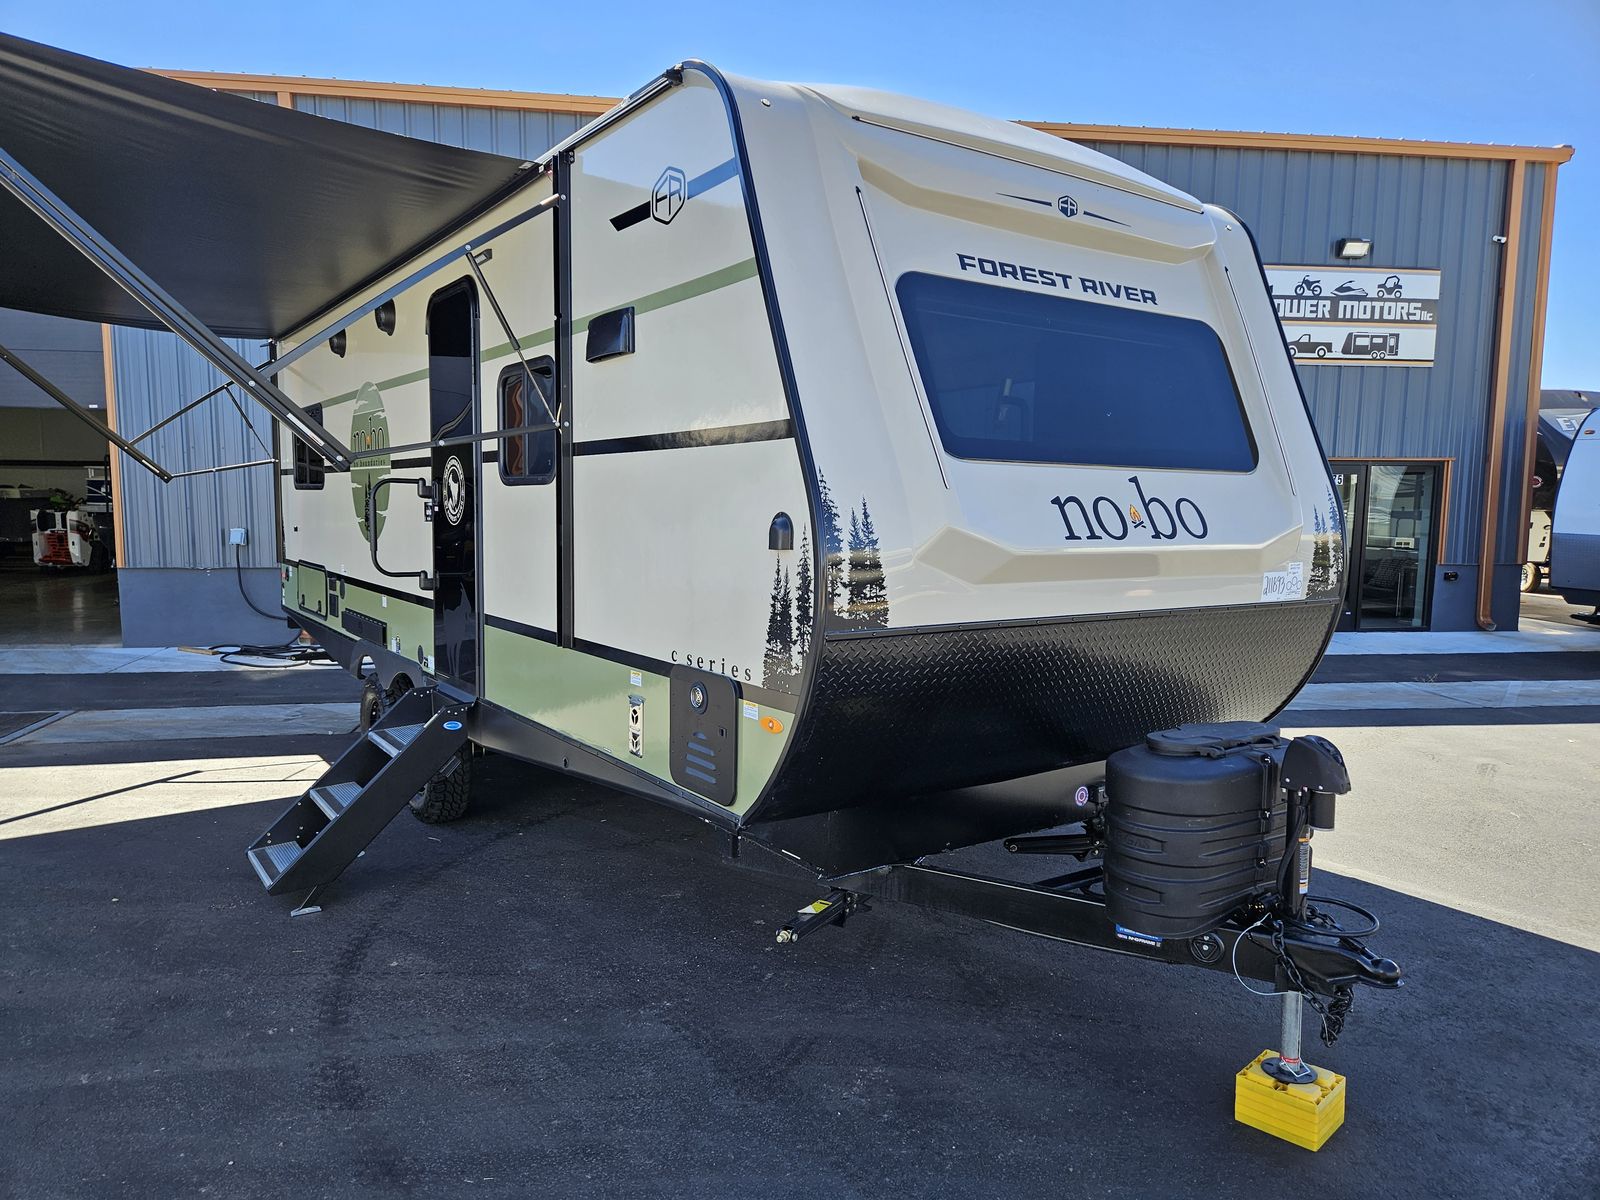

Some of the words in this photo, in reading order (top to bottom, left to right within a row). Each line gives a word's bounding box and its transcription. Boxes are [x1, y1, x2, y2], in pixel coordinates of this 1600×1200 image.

[956, 253, 1073, 290] FOREST
[1079, 277, 1159, 306] RIVER
[1338, 300, 1422, 321] MOTORS
[686, 653, 753, 683] series
